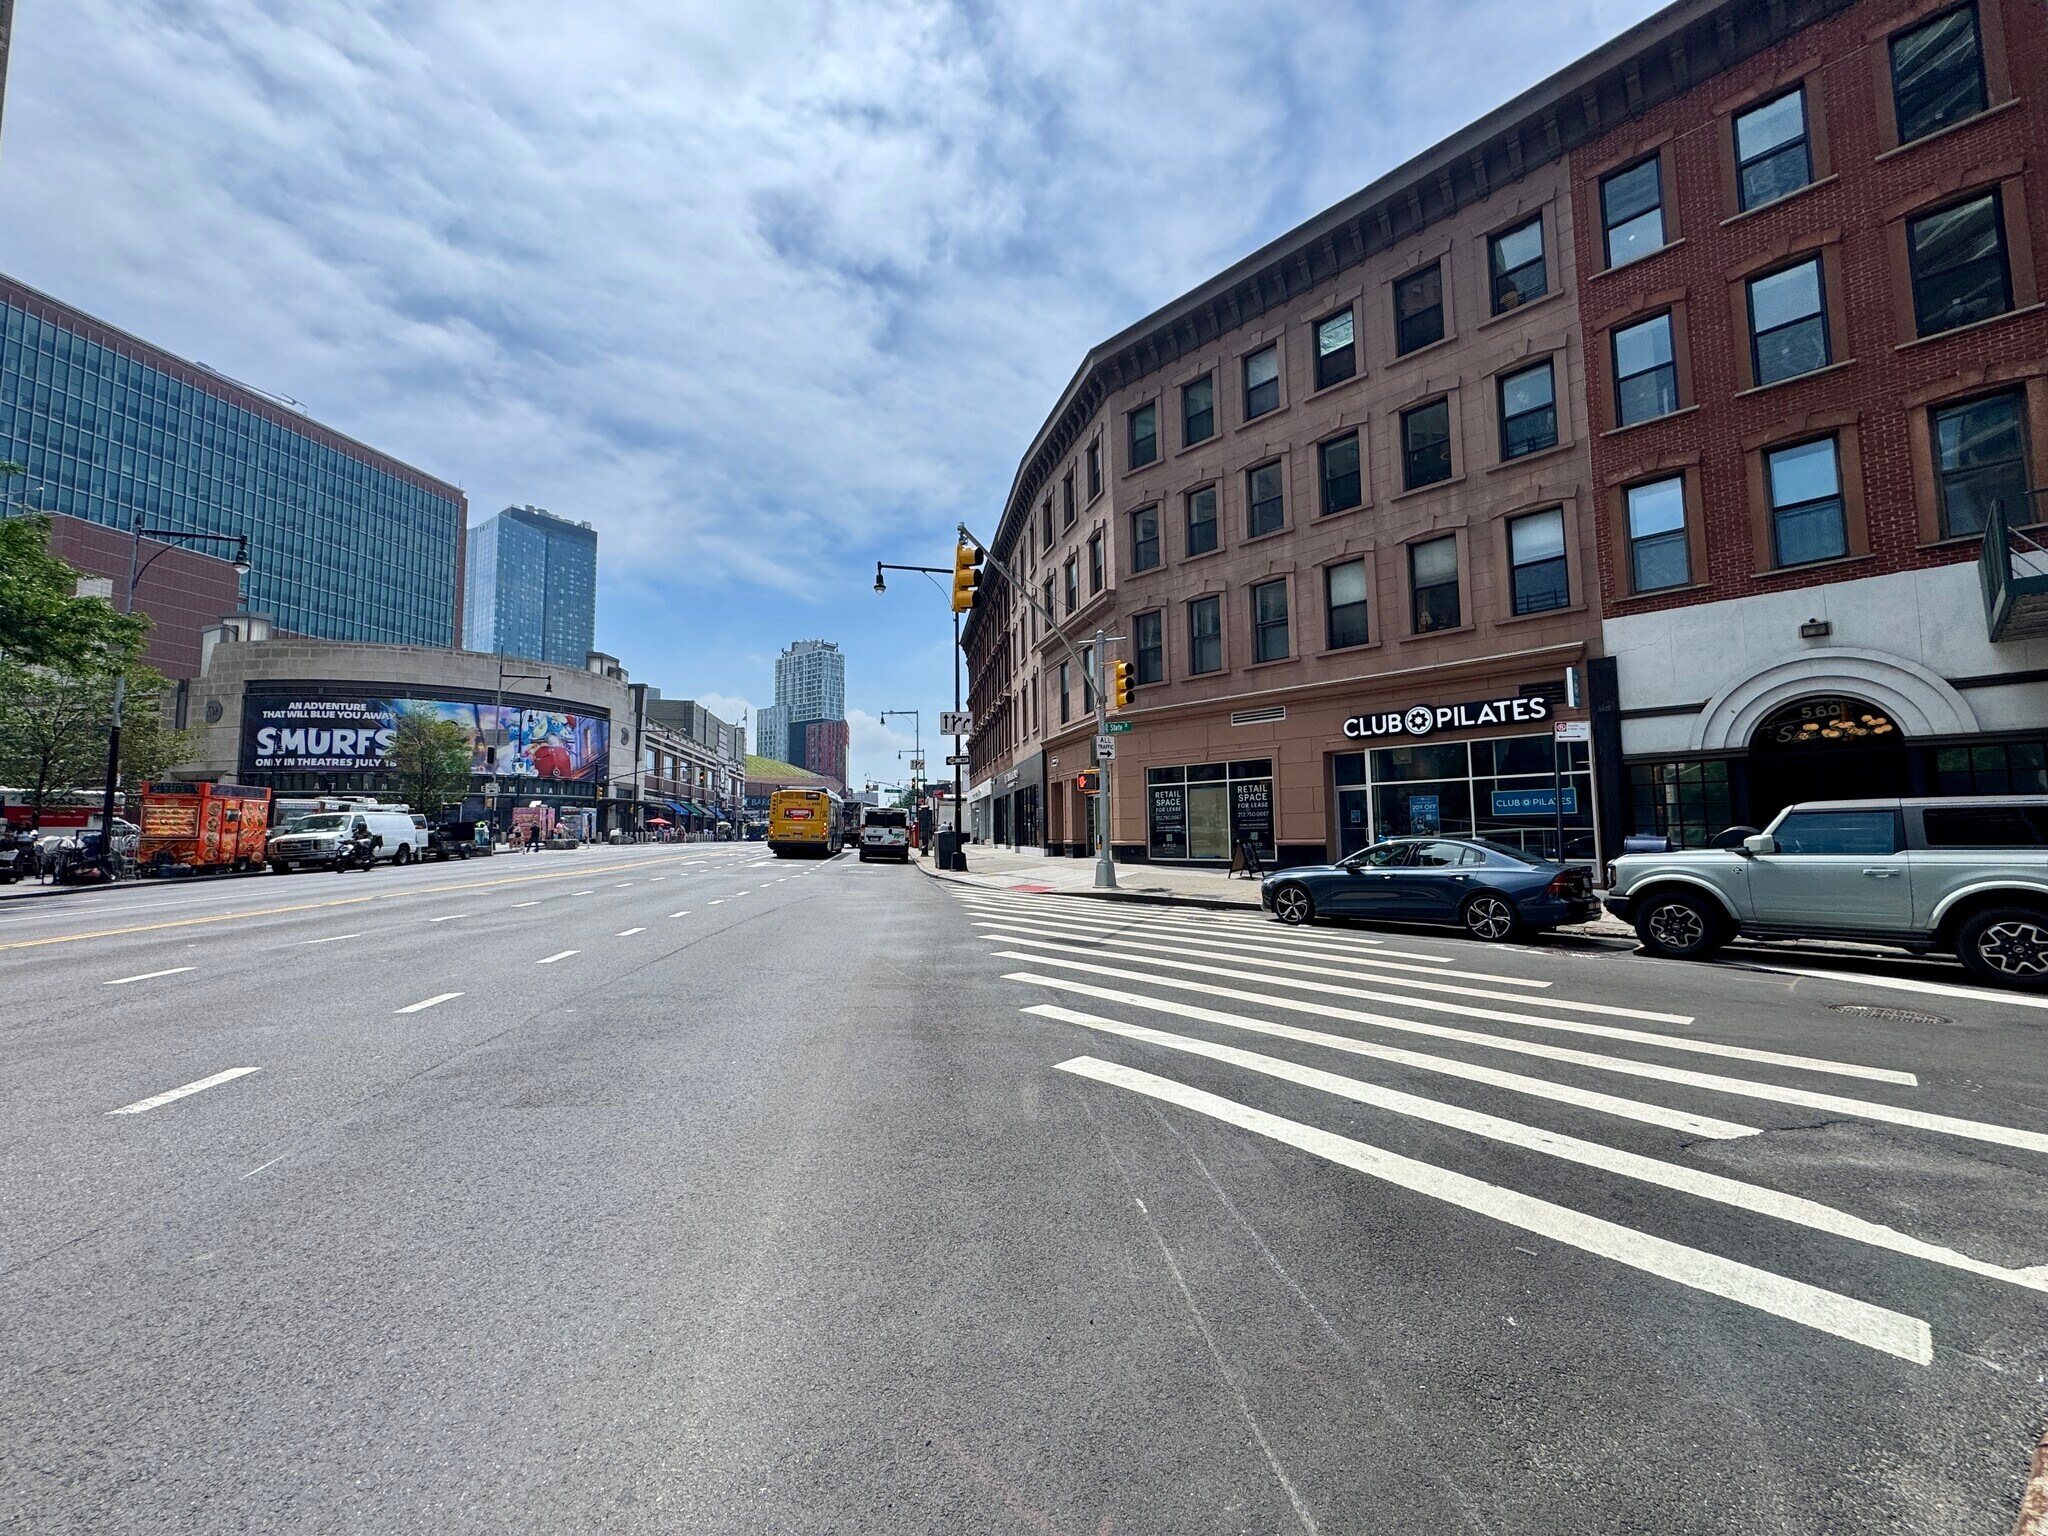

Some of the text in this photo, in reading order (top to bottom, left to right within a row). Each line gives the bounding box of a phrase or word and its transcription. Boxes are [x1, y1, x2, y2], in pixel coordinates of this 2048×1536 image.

[288, 702, 366, 711] AN ADVENTURE
[1801, 705, 1841, 718] 560
[262, 710, 397, 720] THAT WILL BLUE YOU AWAY
[1343, 697, 1546, 737] CLUB PILATES
[1110, 723, 1123, 731] State
[256, 726, 398, 756] SMURFS
[284, 758, 295, 766] IN
[297, 758, 353, 767] THEATRES
[354, 758, 382, 768] JULY
[466, 784, 565, 795] TEMINAL
[1237, 784, 1268, 794] RETAIL
[1155, 790, 1181, 799] RETAIL
[1238, 793, 1268, 802] SPACE
[1156, 798, 1181, 807] SPACE
[1496, 797, 1572, 807] CLUB PILAES
